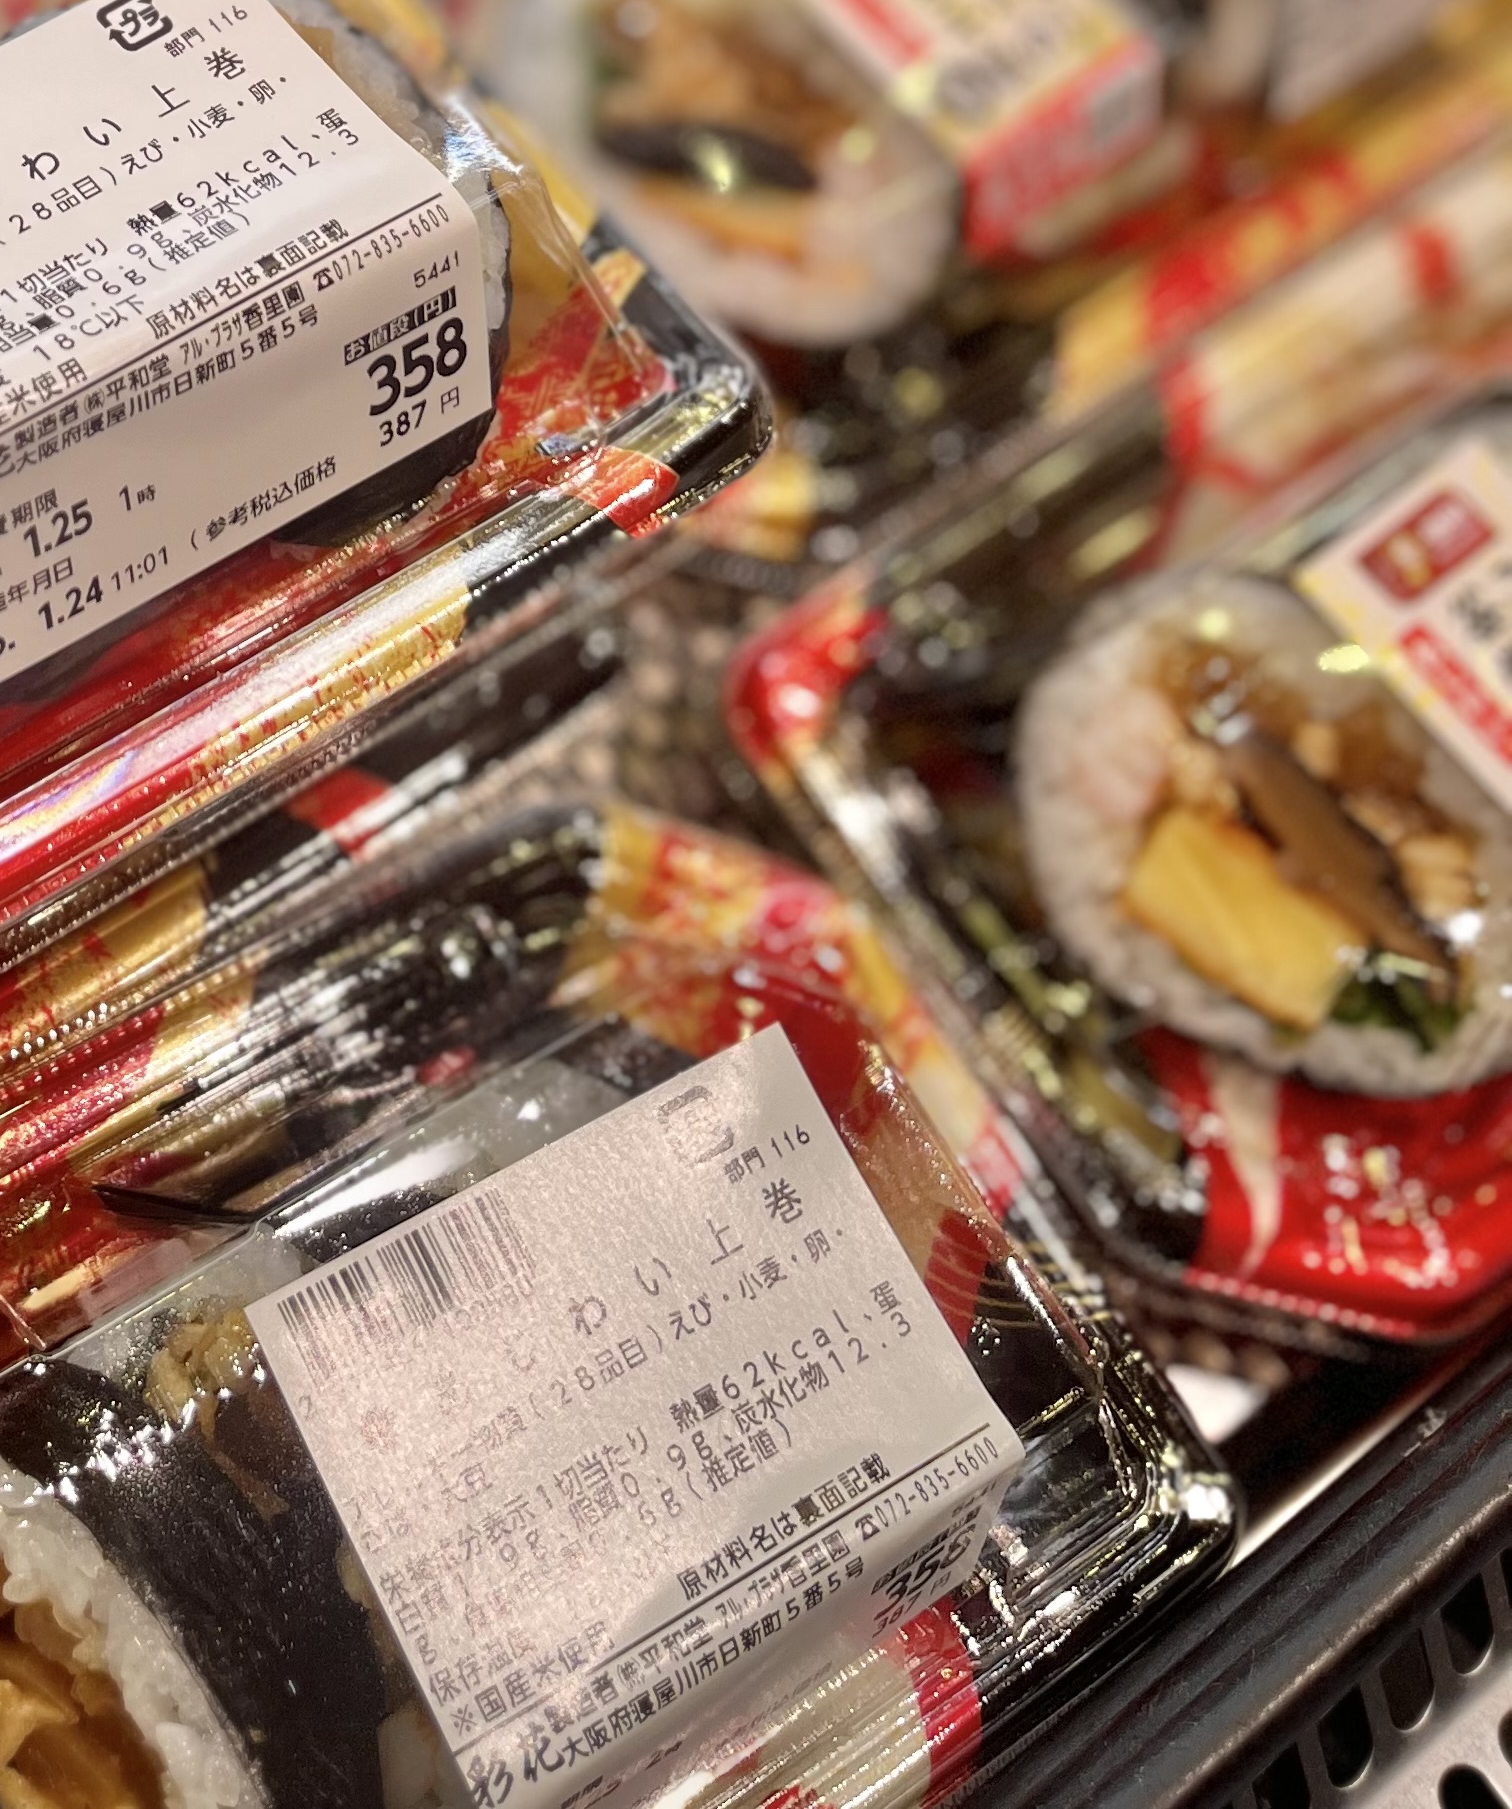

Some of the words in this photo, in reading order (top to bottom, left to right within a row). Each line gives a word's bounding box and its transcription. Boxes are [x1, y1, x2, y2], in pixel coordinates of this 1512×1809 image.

[163, 26, 205, 58] 部門
[208, 5, 249, 34] 116
[145, 218, 350, 339] 原材料名は裏面記載
[412, 249, 461, 288] 5441
[367, 317, 467, 416] 358
[22, 498, 94, 559] 1.25
[37, 575, 105, 632] 1.24
[110, 545, 170, 592] 11:01
[378, 400, 428, 447] 387
[439, 385, 461, 415] 円
[723, 1149, 766, 1185] 部門
[770, 1124, 811, 1159] 116
[675, 1451, 892, 1603] 原材料名は裏面記載
